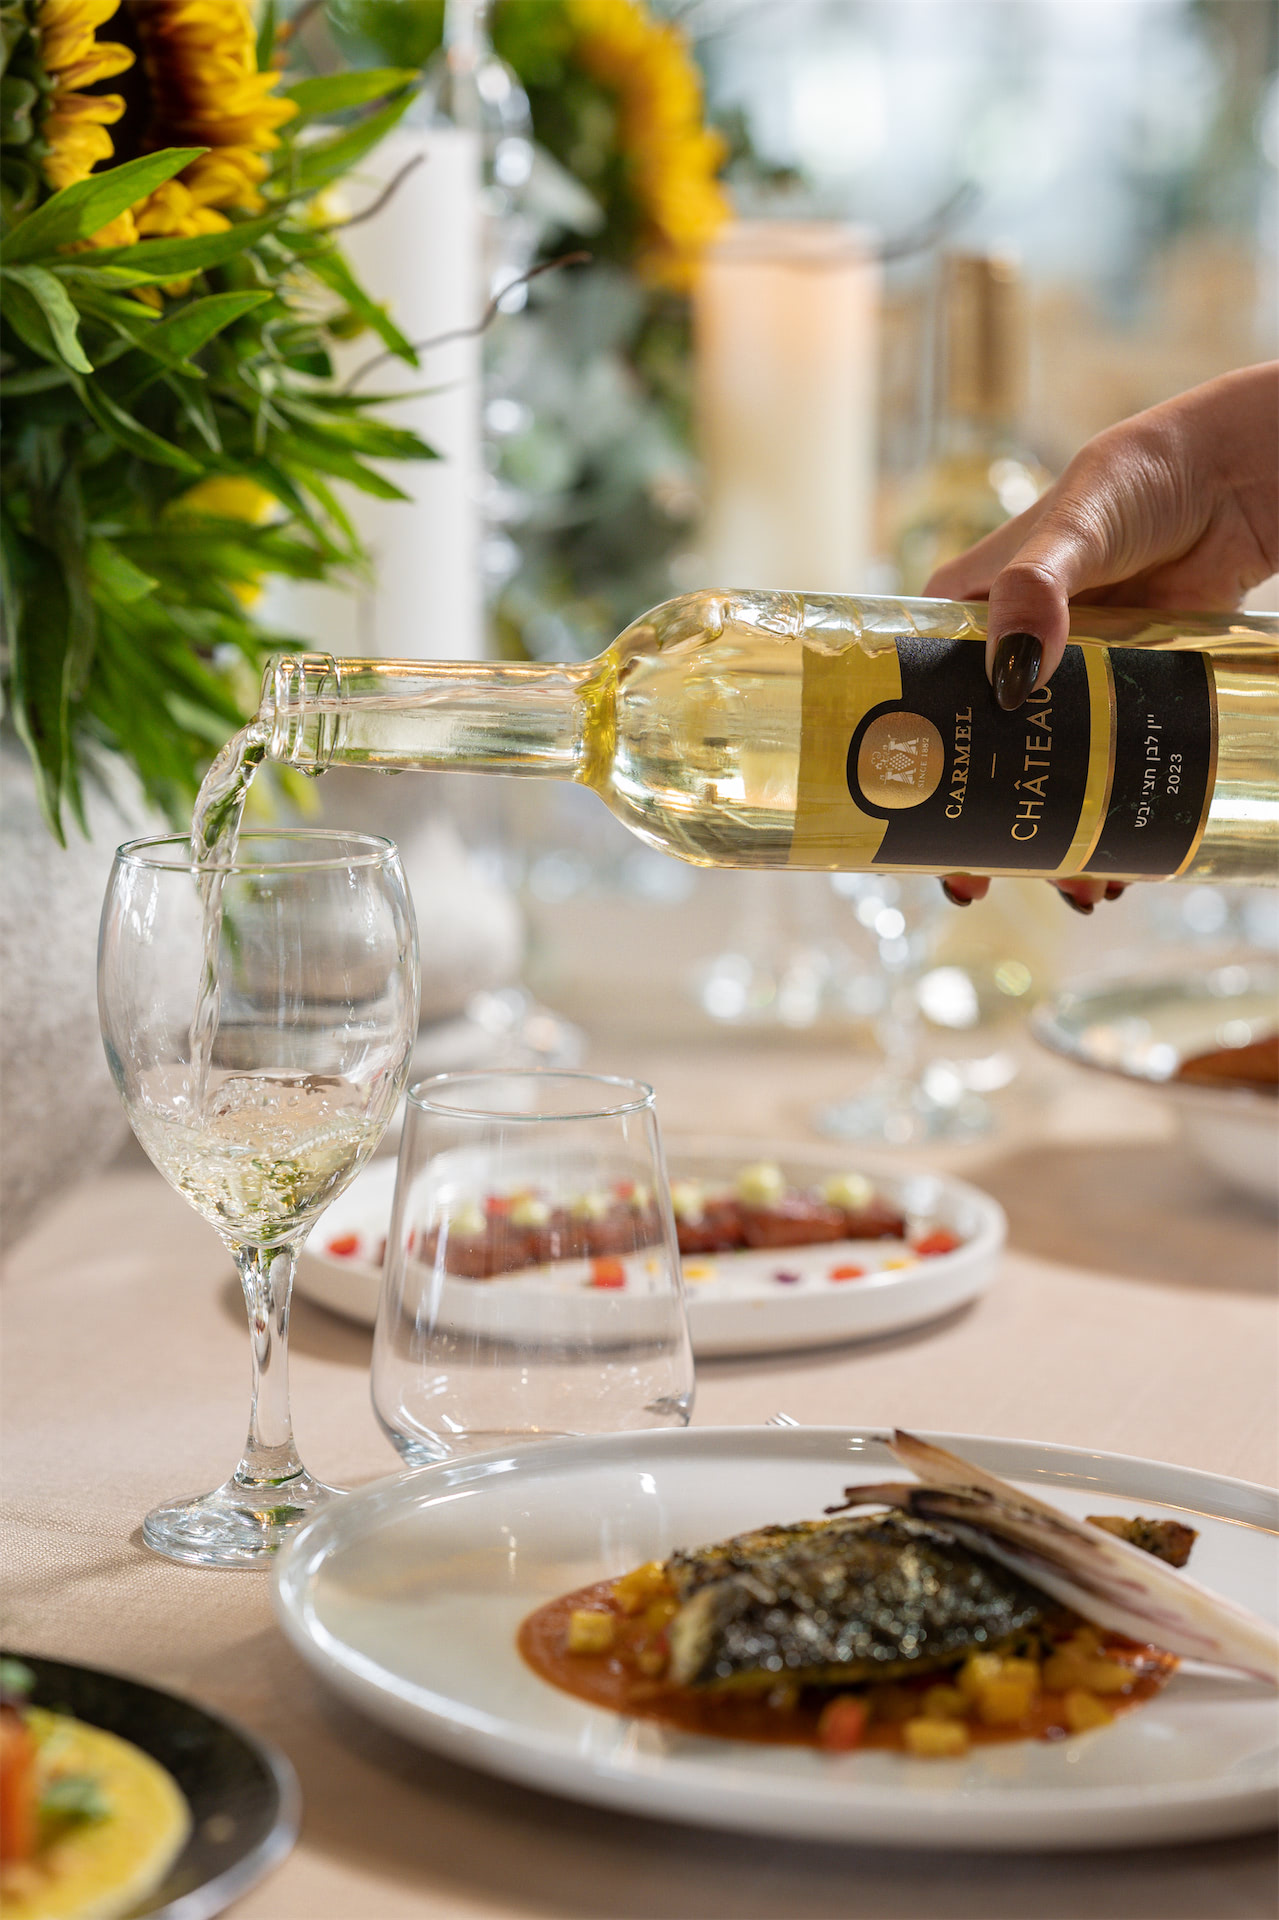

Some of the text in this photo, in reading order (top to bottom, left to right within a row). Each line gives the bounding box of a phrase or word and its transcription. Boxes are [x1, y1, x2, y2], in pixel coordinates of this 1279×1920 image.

[917, 736, 930, 788] SINCE 1882
[945, 706, 973, 819] CARMEL
[1010, 685, 1053, 841] CHÂTEAU
[1134, 713, 1162, 828] יין לבן חצי יבש
[1166, 753, 1183, 795] 2023
